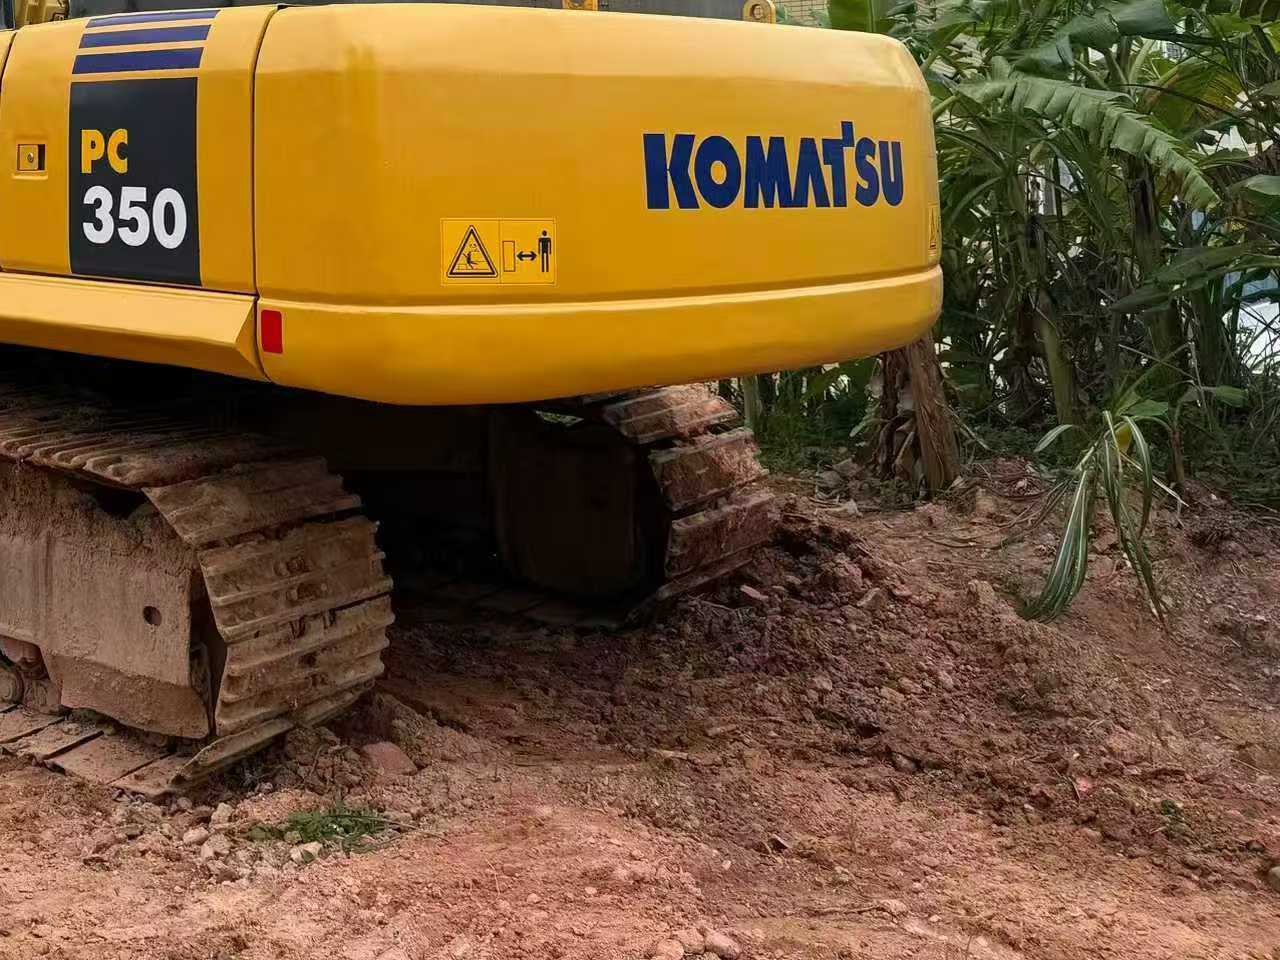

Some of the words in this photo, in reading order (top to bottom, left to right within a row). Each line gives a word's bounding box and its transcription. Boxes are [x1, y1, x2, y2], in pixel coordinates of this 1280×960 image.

[81, 128, 128, 174] PC
[643, 121, 904, 209] KOMATSU
[82, 185, 187, 249] 350
